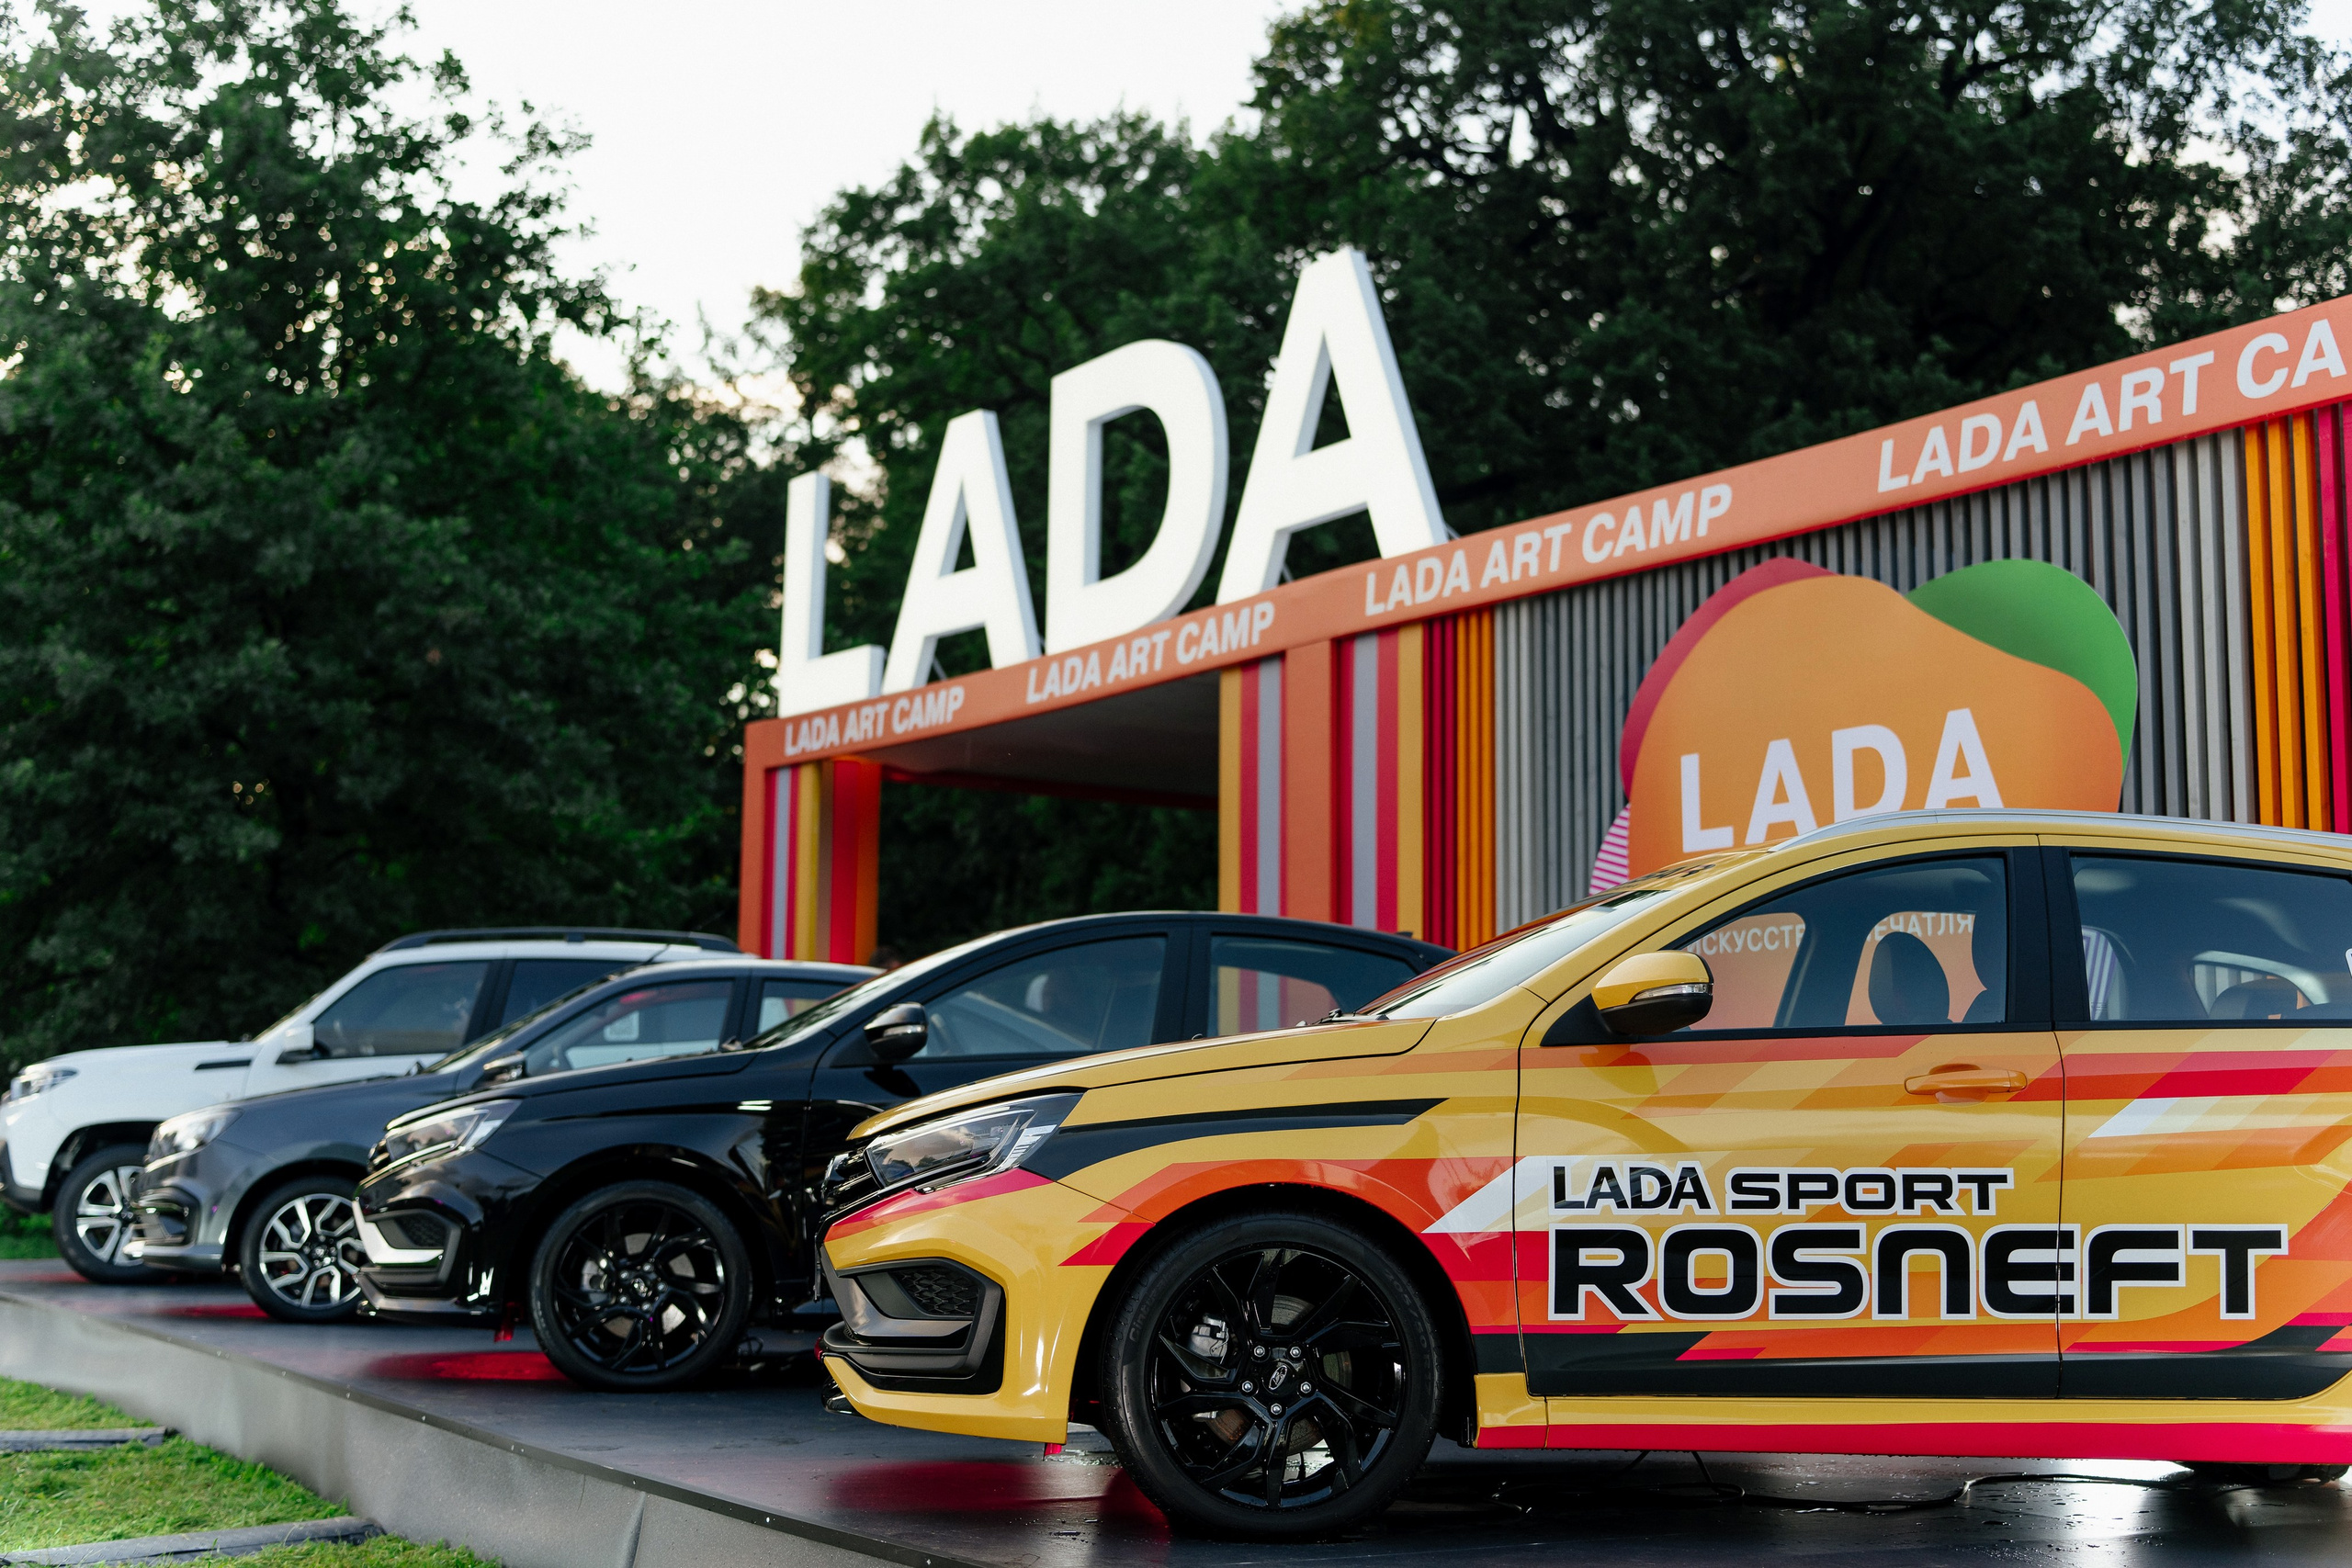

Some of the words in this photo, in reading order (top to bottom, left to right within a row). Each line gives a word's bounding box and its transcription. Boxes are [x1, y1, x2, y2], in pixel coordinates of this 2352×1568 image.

[1878, 400, 2048, 492] LADA
[2066, 351, 2214, 445] ART
[2237, 319, 2346, 399] CA
[778, 248, 1448, 717] LADA
[1365, 549, 1470, 616] LADA
[1479, 523, 1573, 589] ART
[1582, 483, 1733, 563] CAMP
[1025, 650, 1102, 705] LADA
[1107, 630, 1172, 684] ART
[1176, 602, 1275, 664] CAMP
[784, 714, 840, 756] LADA
[842, 702, 890, 744] ART
[891, 685, 965, 734] CAMP
[1680, 708, 2004, 852] LADA
[1552, 1165, 1713, 1211] LADA
[1731, 1172, 2009, 1212] SPORT
[1553, 1228, 2283, 1315] ROSNEFT
